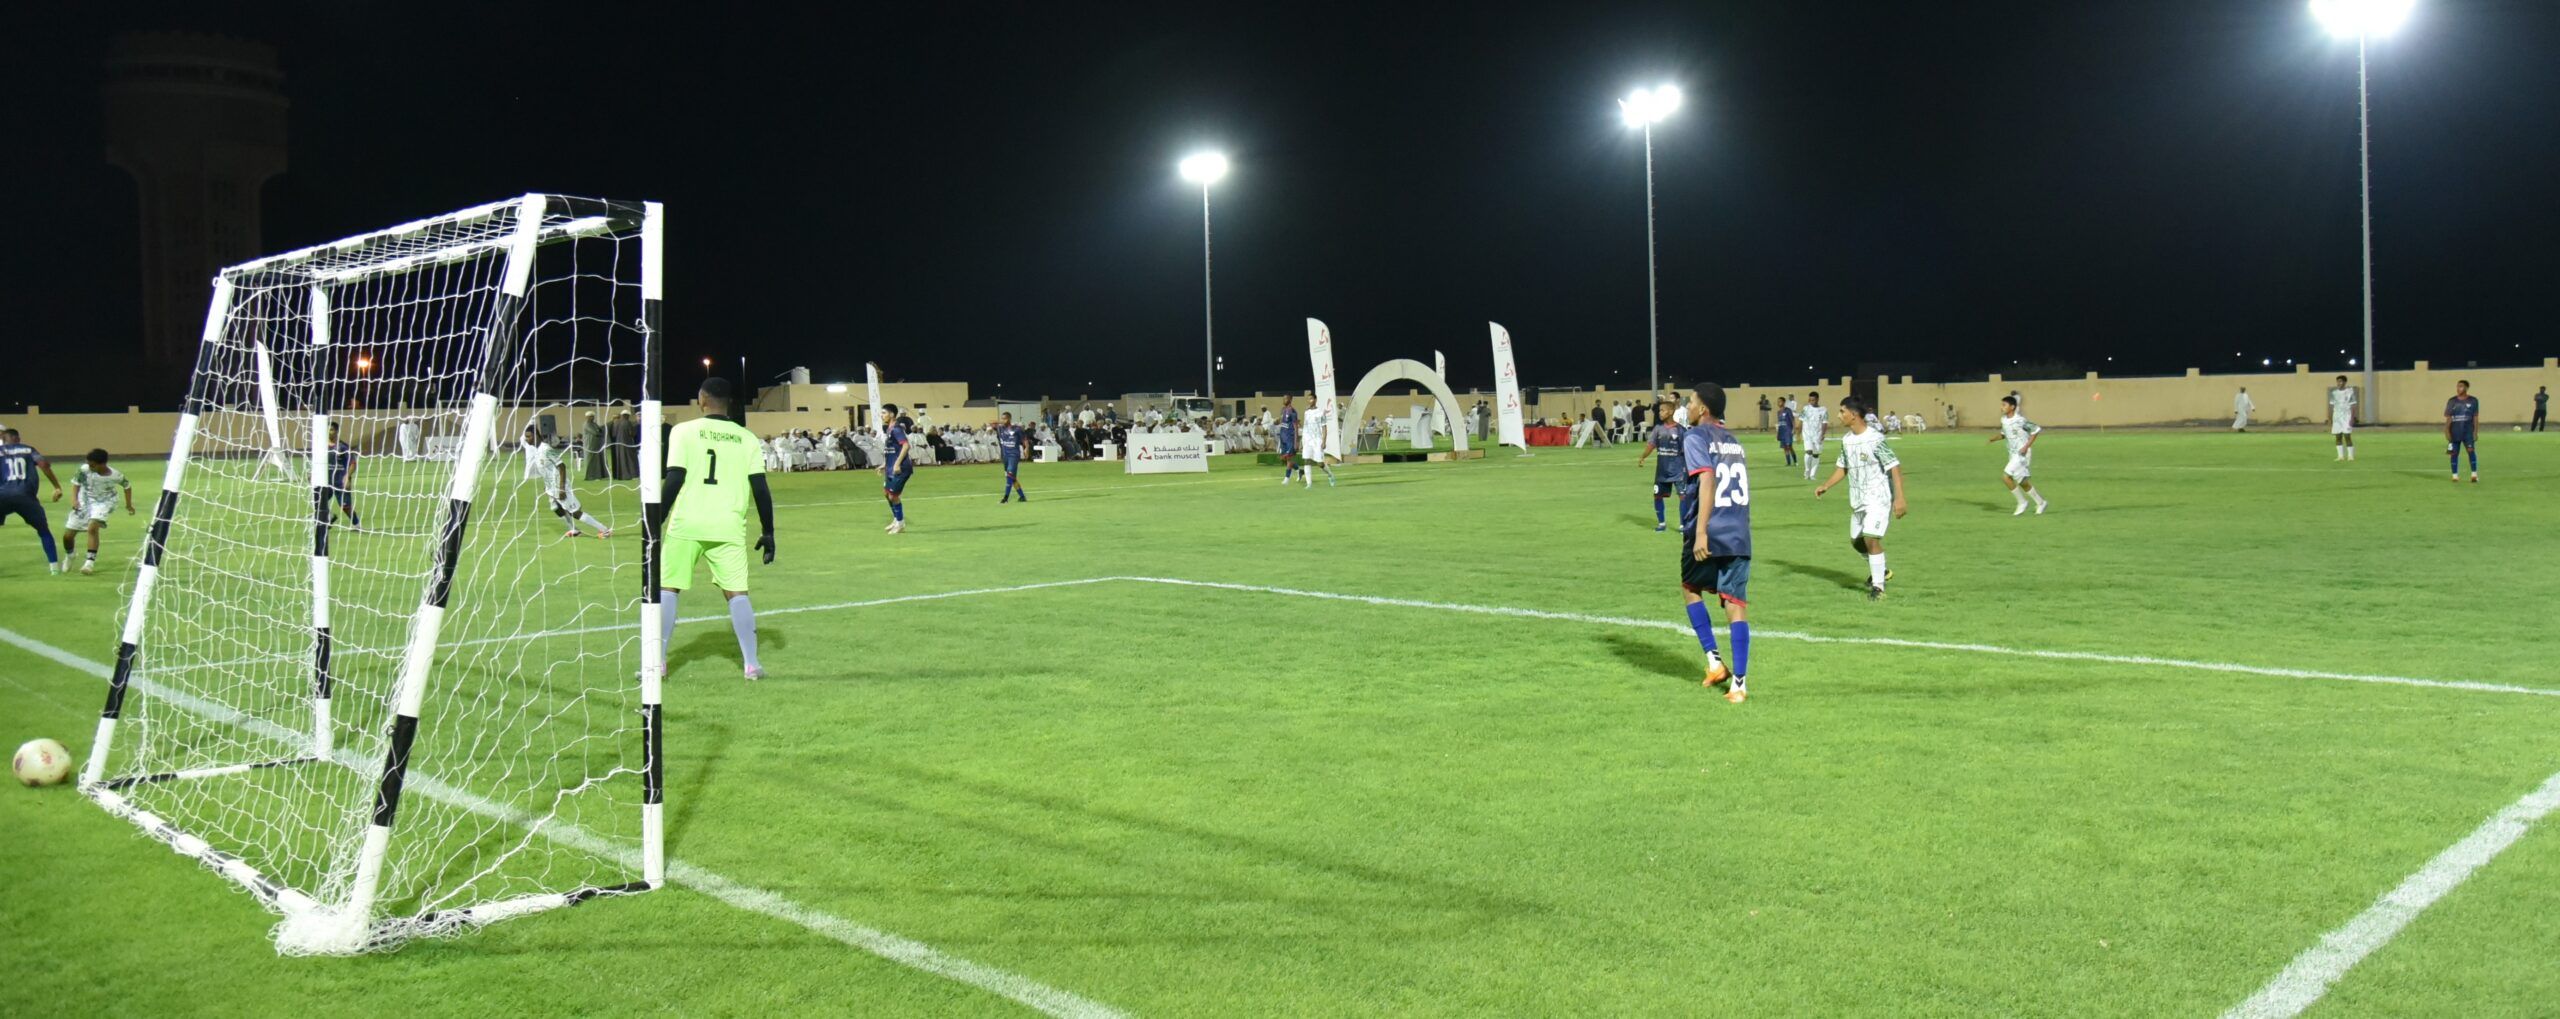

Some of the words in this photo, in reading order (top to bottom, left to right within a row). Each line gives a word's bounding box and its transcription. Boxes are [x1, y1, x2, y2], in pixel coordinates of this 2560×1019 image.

[1709, 442, 1718, 454] AL
[5, 457, 27, 481] 10
[703, 448, 718, 486] 1
[1714, 462, 1749, 508] 23
